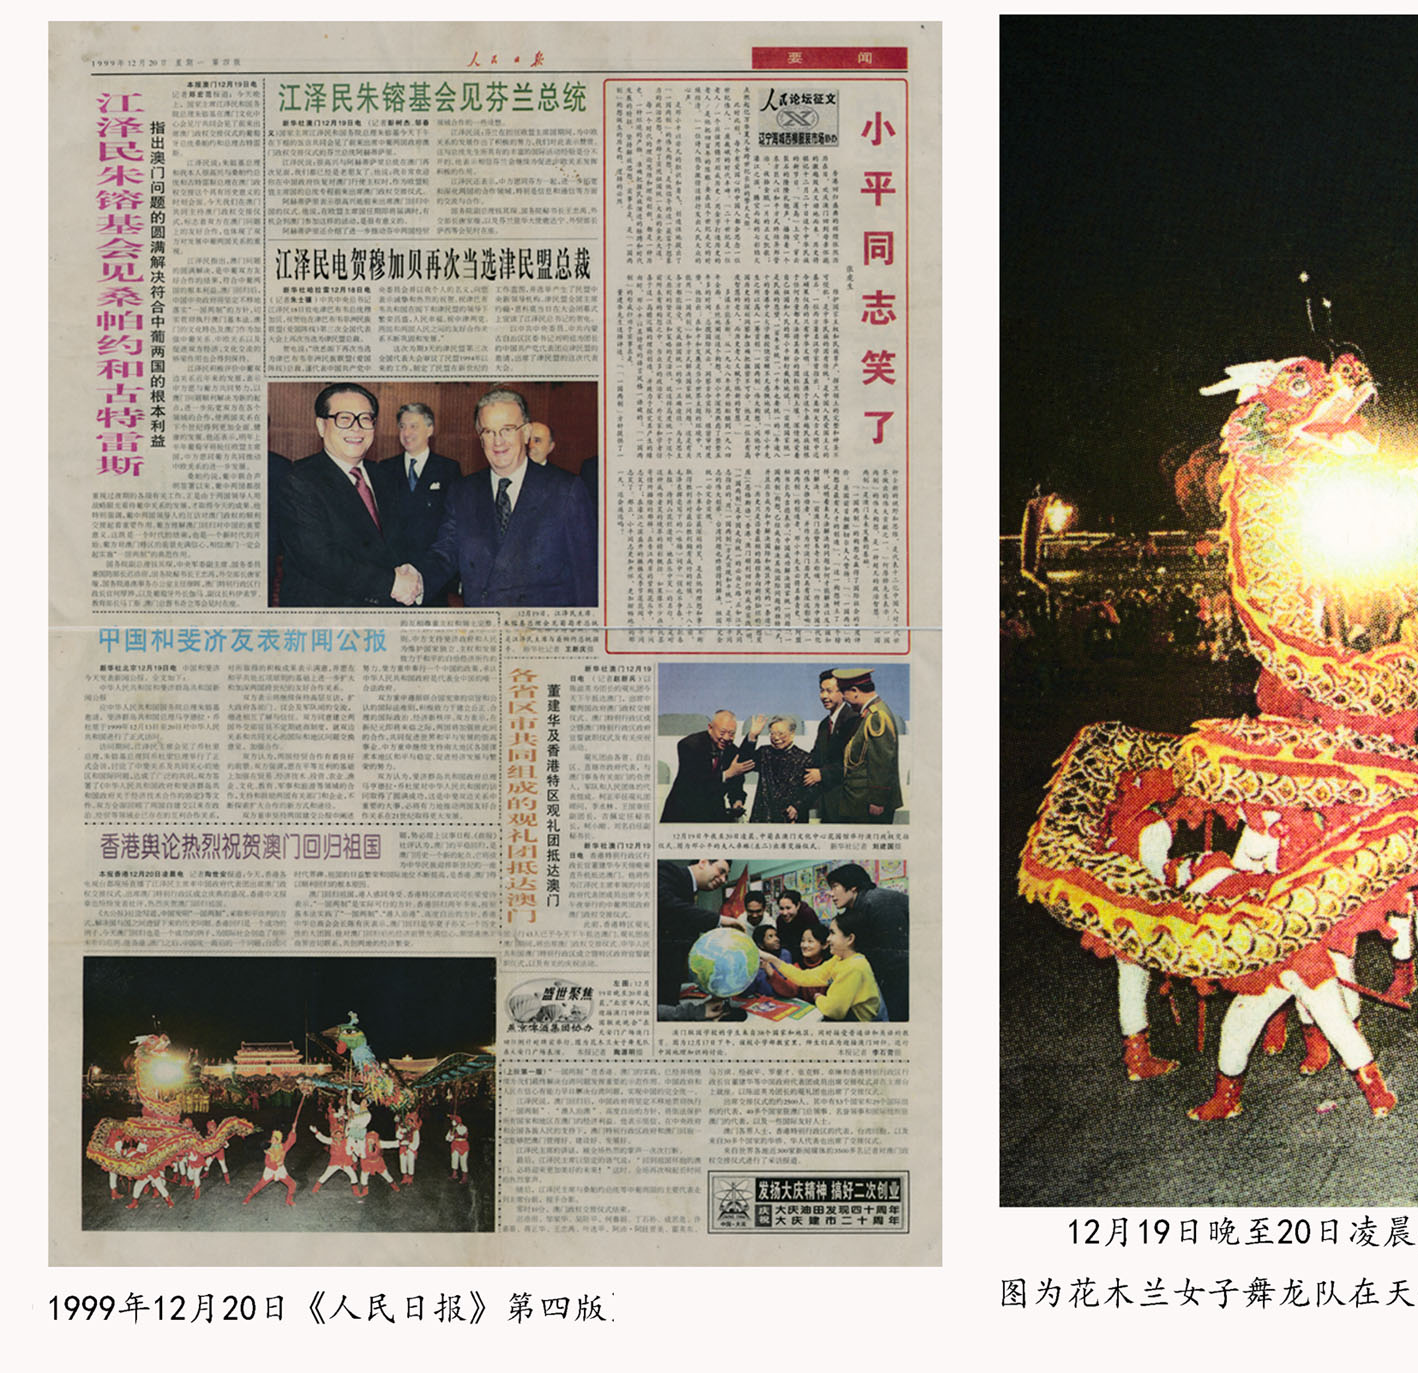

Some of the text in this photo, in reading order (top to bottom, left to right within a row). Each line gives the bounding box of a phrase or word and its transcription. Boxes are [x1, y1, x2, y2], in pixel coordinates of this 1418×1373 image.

[788, 52, 873, 64] 要闻
[278, 81, 587, 114] 江泽民朱镕基会见芬兰总统
[275, 247, 591, 282] 江泽民电贺穆加贝再次当选津民盟总裁
[860, 111, 897, 445] 小平同志笑了
[96, 92, 145, 477] 江泽民朱镕基会见桑帕约和古特雷斯
[149, 120, 166, 448] 指出澳门问题的圆满解决符合中葡两国的根本利益
[99, 627, 387, 653] 中国和斐济发表新闻公报
[507, 667, 539, 925] 各省区市共同组成的观礼团抵达澳门
[547, 684, 561, 908] 董建华及香港特区观礼团抵达澳门
[100, 832, 381, 860] 香港舆论热烈祝贺澳门回归祖国
[541, 986, 595, 1001] 盛世聚焦
[758, 1181, 900, 1200] 发扬大庆精神 搞好二次创业
[775, 1205, 900, 1215] 大庆油田发现四十周年
[775, 1216, 900, 1226] 大庆建市二十周年
